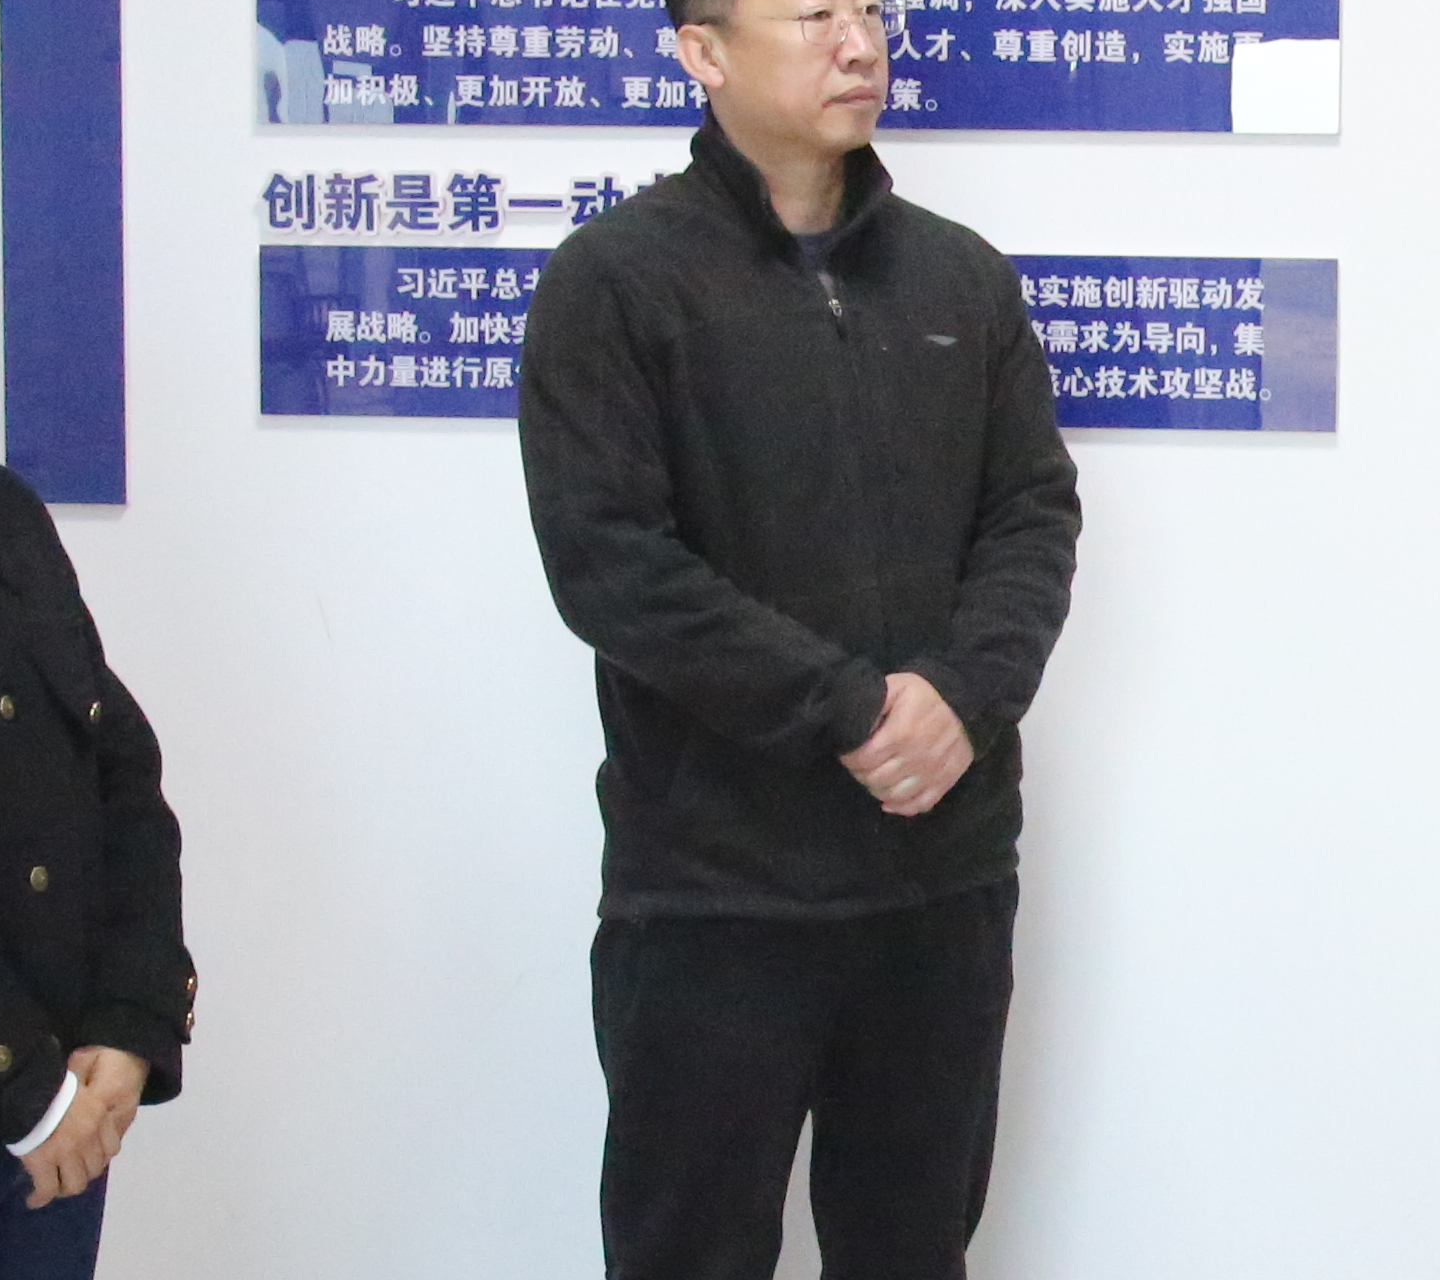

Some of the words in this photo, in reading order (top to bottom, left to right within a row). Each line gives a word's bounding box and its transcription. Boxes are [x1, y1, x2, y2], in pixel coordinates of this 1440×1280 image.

[262, 172, 665, 233] 创新是第一动
[326, 355, 521, 390] 中力量进行原
